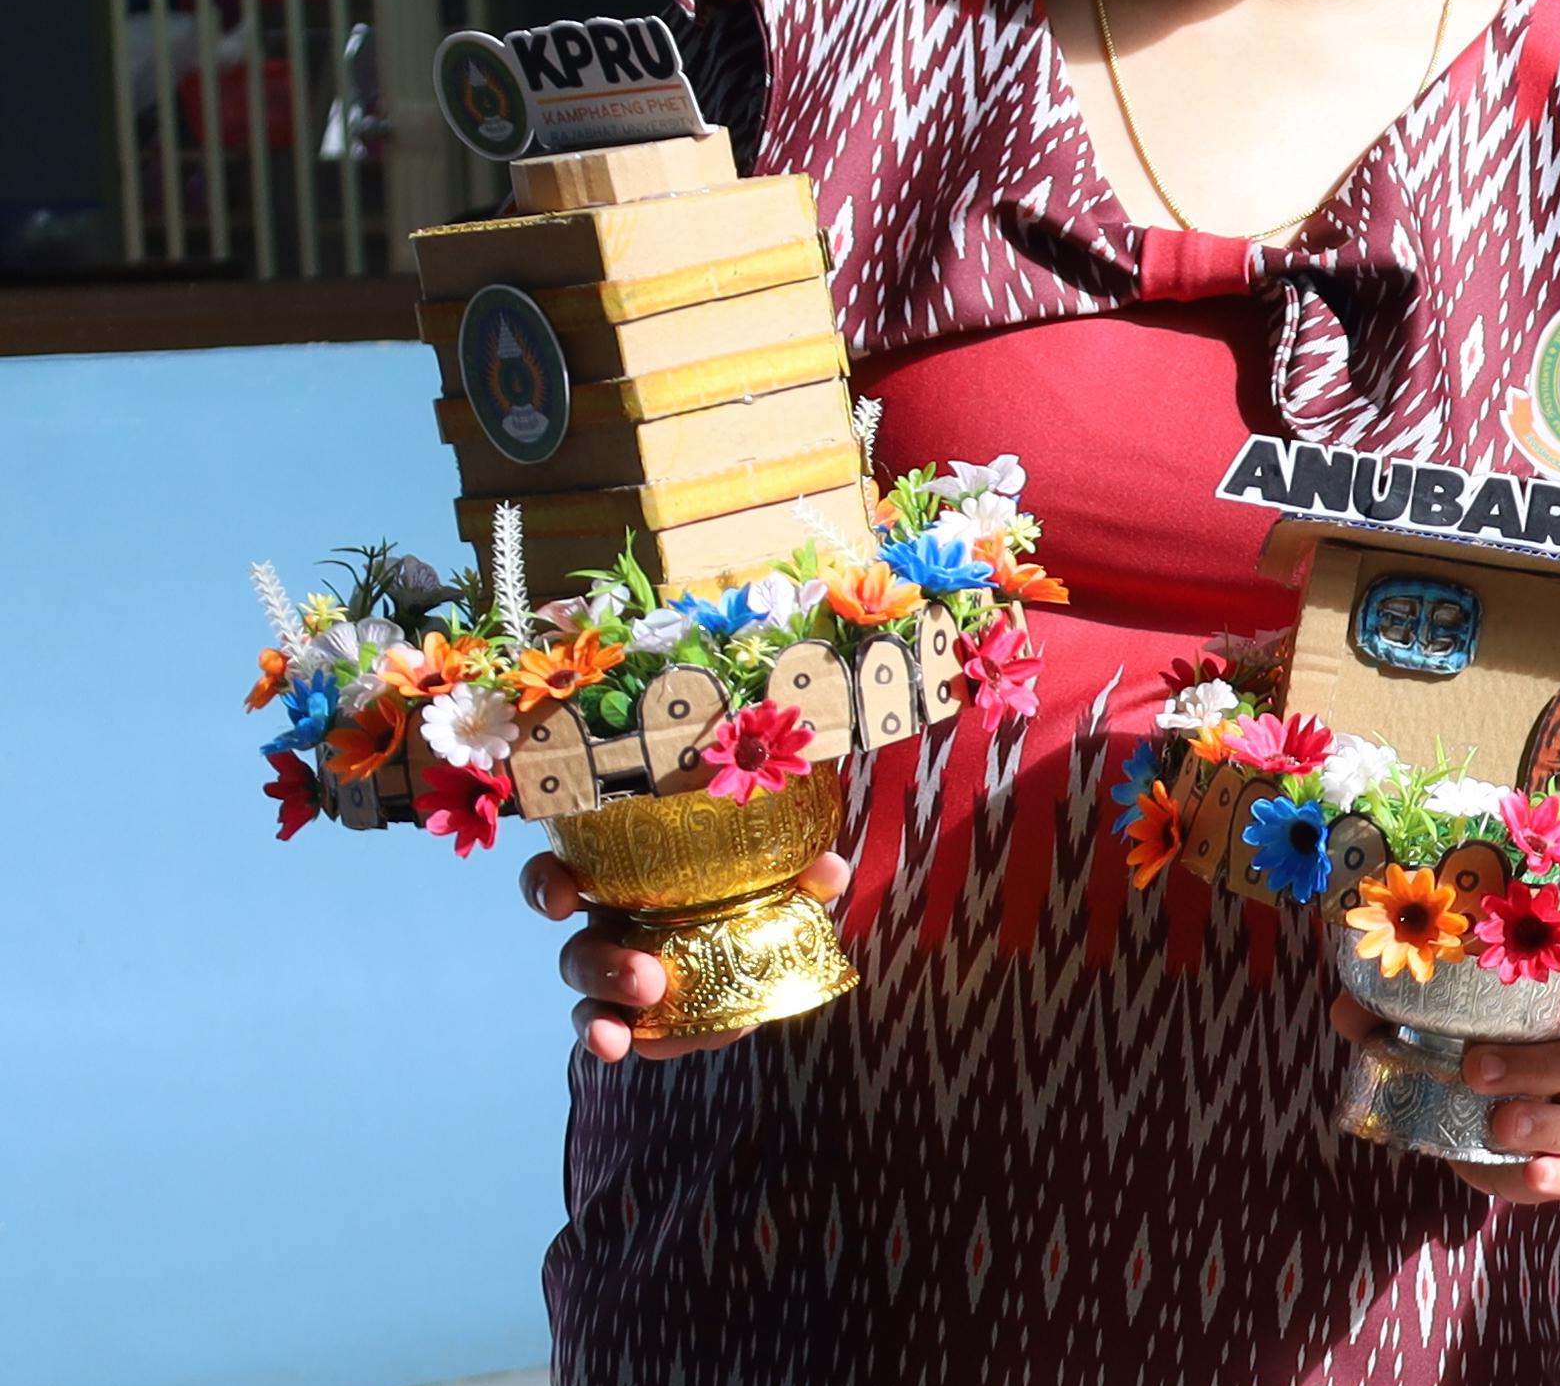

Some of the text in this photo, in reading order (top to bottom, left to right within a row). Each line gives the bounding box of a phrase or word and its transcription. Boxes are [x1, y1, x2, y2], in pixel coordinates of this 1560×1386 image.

[511, 20, 676, 92] KPRU
[542, 95, 690, 126] KAMPHAENG PHET
